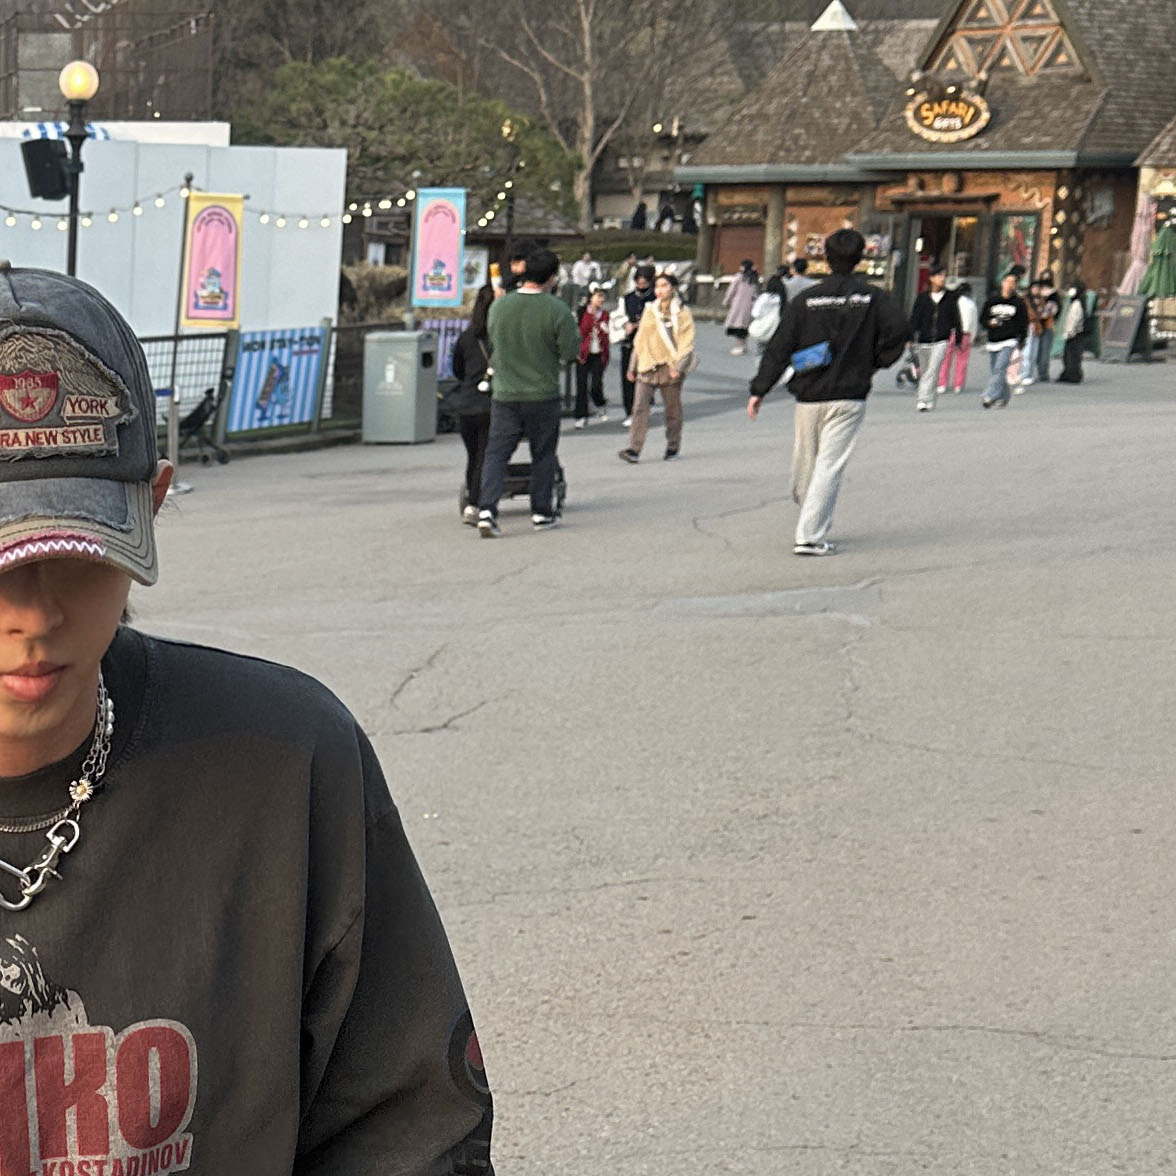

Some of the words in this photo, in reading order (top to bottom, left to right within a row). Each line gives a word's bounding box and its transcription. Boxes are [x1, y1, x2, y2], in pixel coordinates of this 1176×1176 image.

[920, 100, 975, 126] SAFARI
[68, 398, 109, 416] YORK
[26, 430, 59, 446] NEW
[62, 427, 103, 444] STYLE
